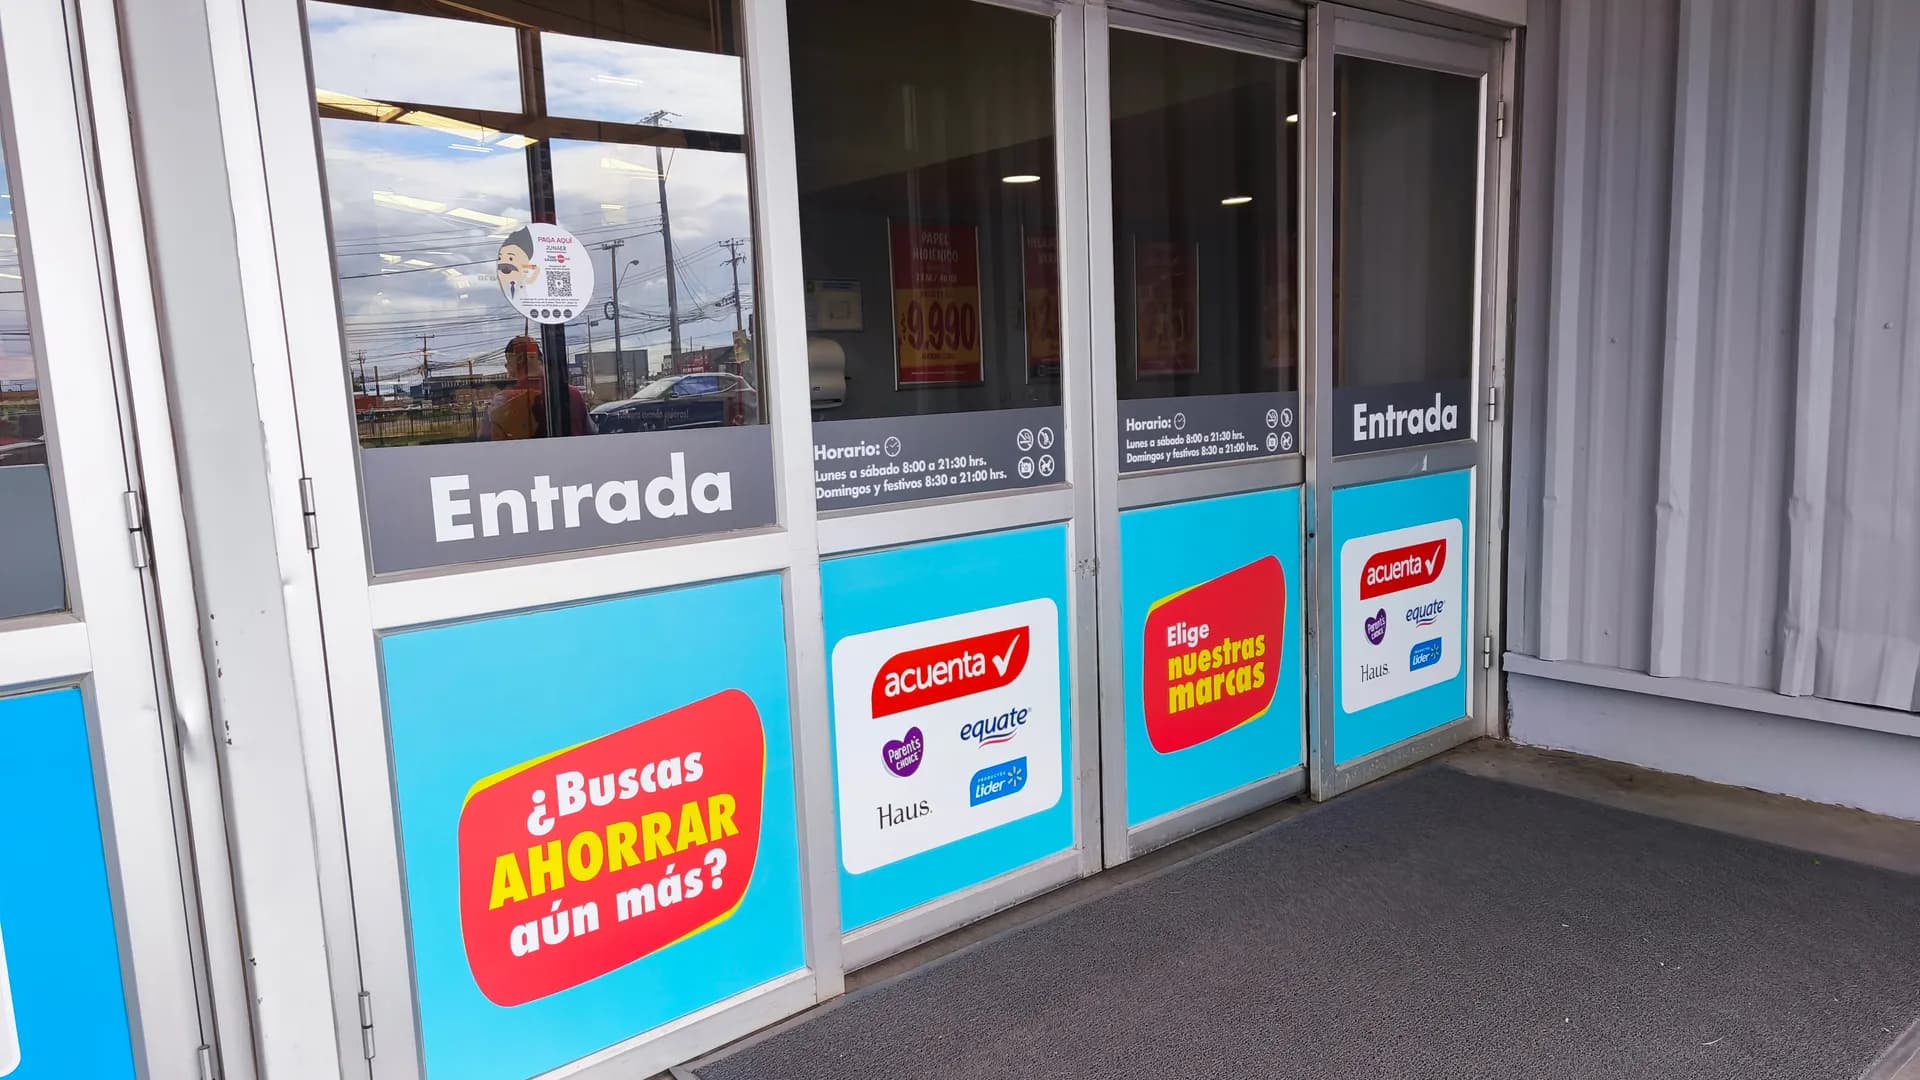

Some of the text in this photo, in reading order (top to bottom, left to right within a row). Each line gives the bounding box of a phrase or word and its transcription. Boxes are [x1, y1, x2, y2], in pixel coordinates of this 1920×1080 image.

[921, 231, 949, 247] PAPEL
[1126, 416, 1171, 432] Horario:
[1353, 392, 1458, 441] Entrada
[814, 440, 880, 461] Horario:
[1126, 438, 1148, 449] Lunes
[1157, 433, 1184, 446] sábado
[1186, 433, 1203, 444] 8:00
[1203, 434, 1209, 442] a
[1210, 431, 1231, 442] 21:30
[1231, 430, 1245, 440] hrs.
[1126, 441, 1259, 464] Domingos y festivos 8:30 a 21:00 hrs.
[815, 455, 987, 483] Lunes a sábado 8:00 a 21:30 hrs.
[816, 468, 1007, 499] Domingos y festivos 8:30 a 21:00 hrs.
[430, 451, 732, 543] Entrada
[1366, 554, 1422, 586] acuenta
[1406, 599, 1444, 623] equate
[1167, 621, 1210, 648] Elige
[1168, 634, 1266, 681] nuestras
[884, 650, 986, 698] acuenta
[1169, 661, 1265, 715] marcas
[960, 706, 1029, 743] equate
[888, 735, 921, 763] Parent's
[895, 751, 919, 771] CHOICE
[526, 751, 704, 837] ¿Buscas
[975, 780, 1006, 799] Lider
[488, 793, 741, 912] AHORRAR
[509, 847, 728, 958] aún más?
